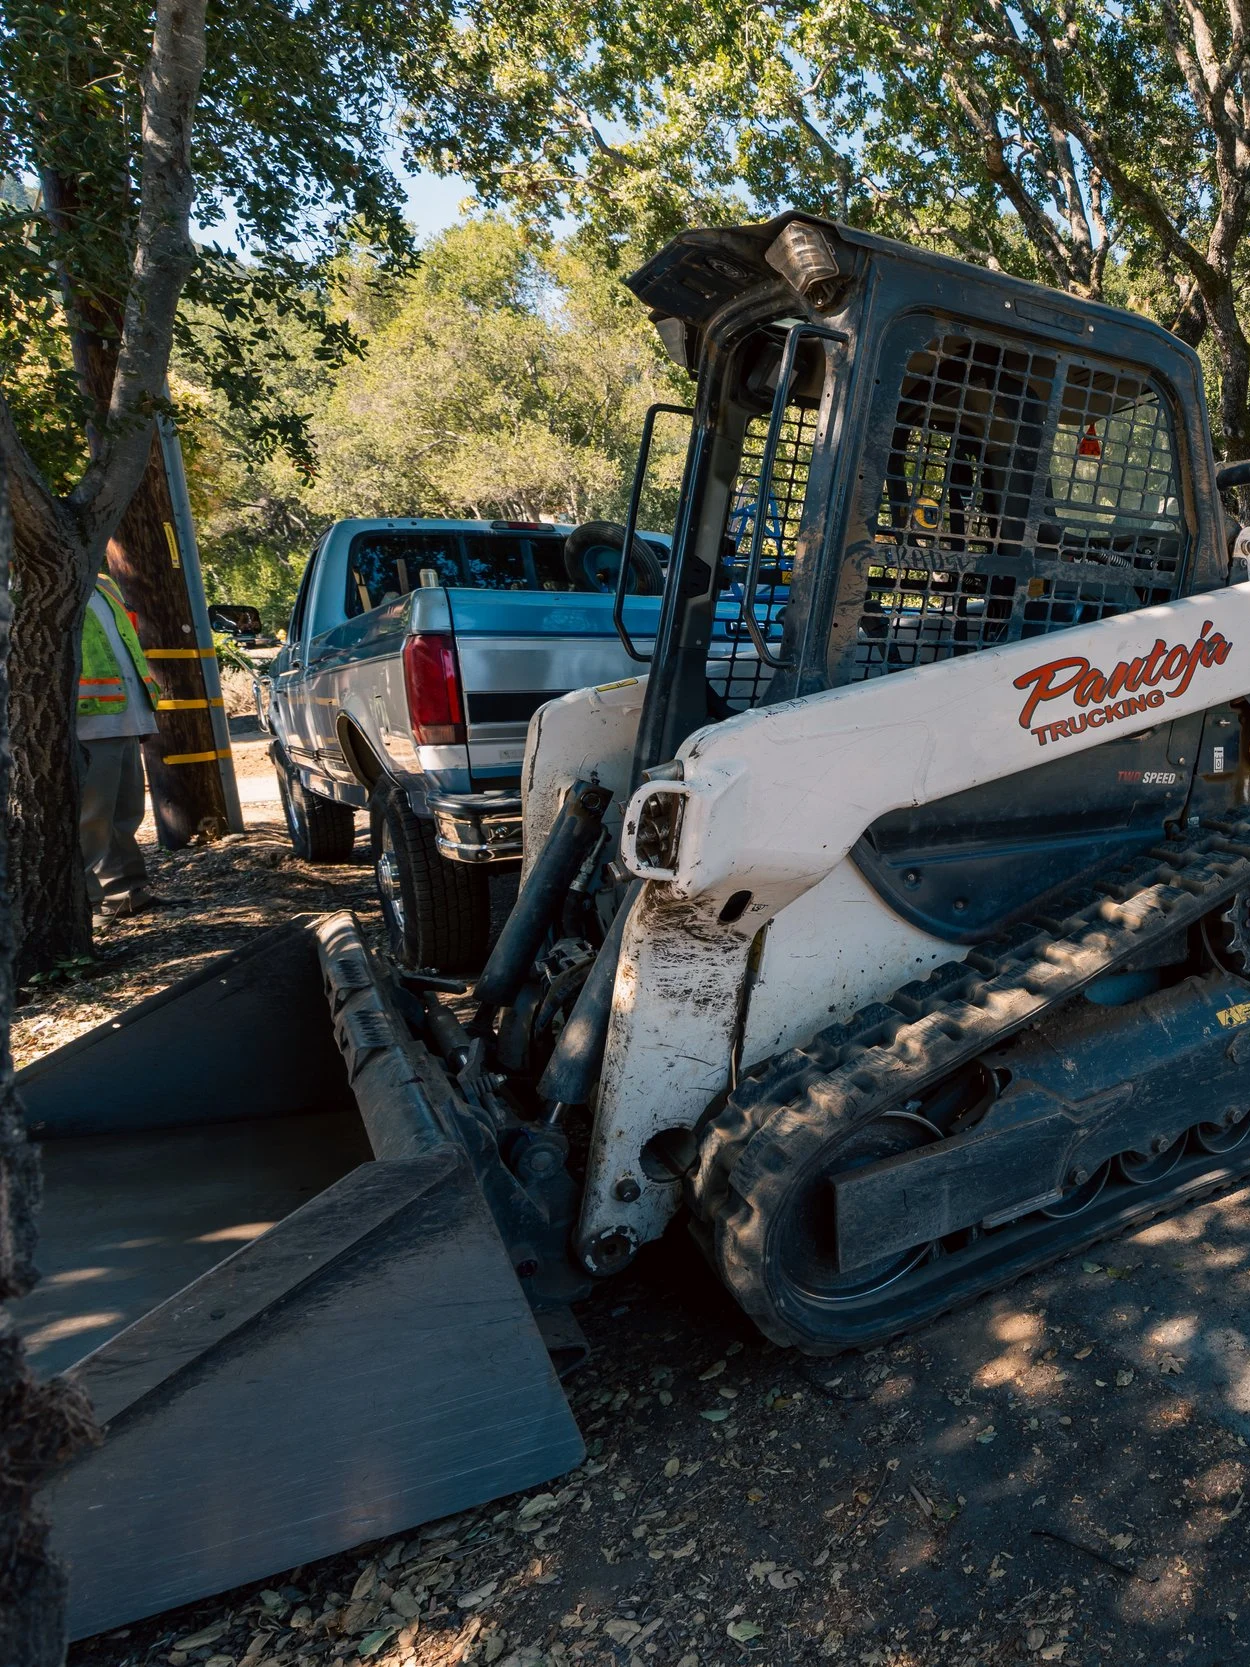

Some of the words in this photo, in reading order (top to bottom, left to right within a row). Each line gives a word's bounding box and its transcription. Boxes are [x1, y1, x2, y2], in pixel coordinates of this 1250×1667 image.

[1013, 620, 1233, 729] Pantoja
[1031, 689, 1165, 746] TRUCKING
[1118, 771, 1141, 782] TWO
[1142, 771, 1176, 784] SPEED
